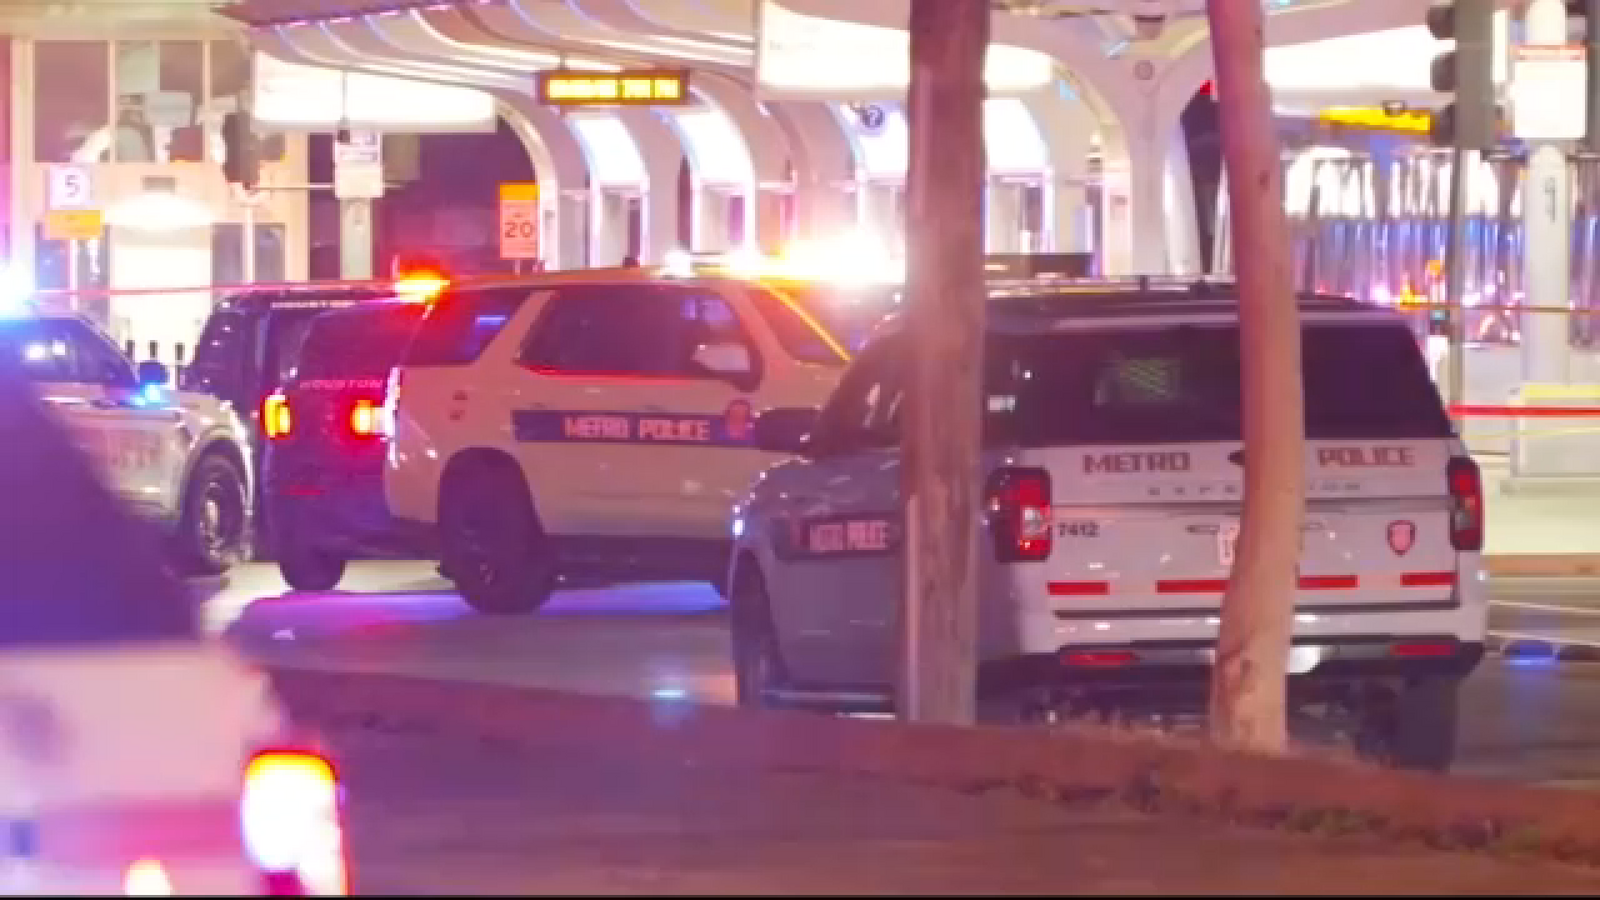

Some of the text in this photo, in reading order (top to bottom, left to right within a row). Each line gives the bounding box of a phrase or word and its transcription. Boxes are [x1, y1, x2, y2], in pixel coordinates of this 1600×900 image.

[64, 174, 80, 198] 5
[504, 222, 536, 238] 20
[563, 416, 711, 440] METRO POLICE
[1082, 447, 1416, 475] METRO POLICE
[846, 520, 889, 550] POLICE
[1057, 521, 1100, 538] 7412
